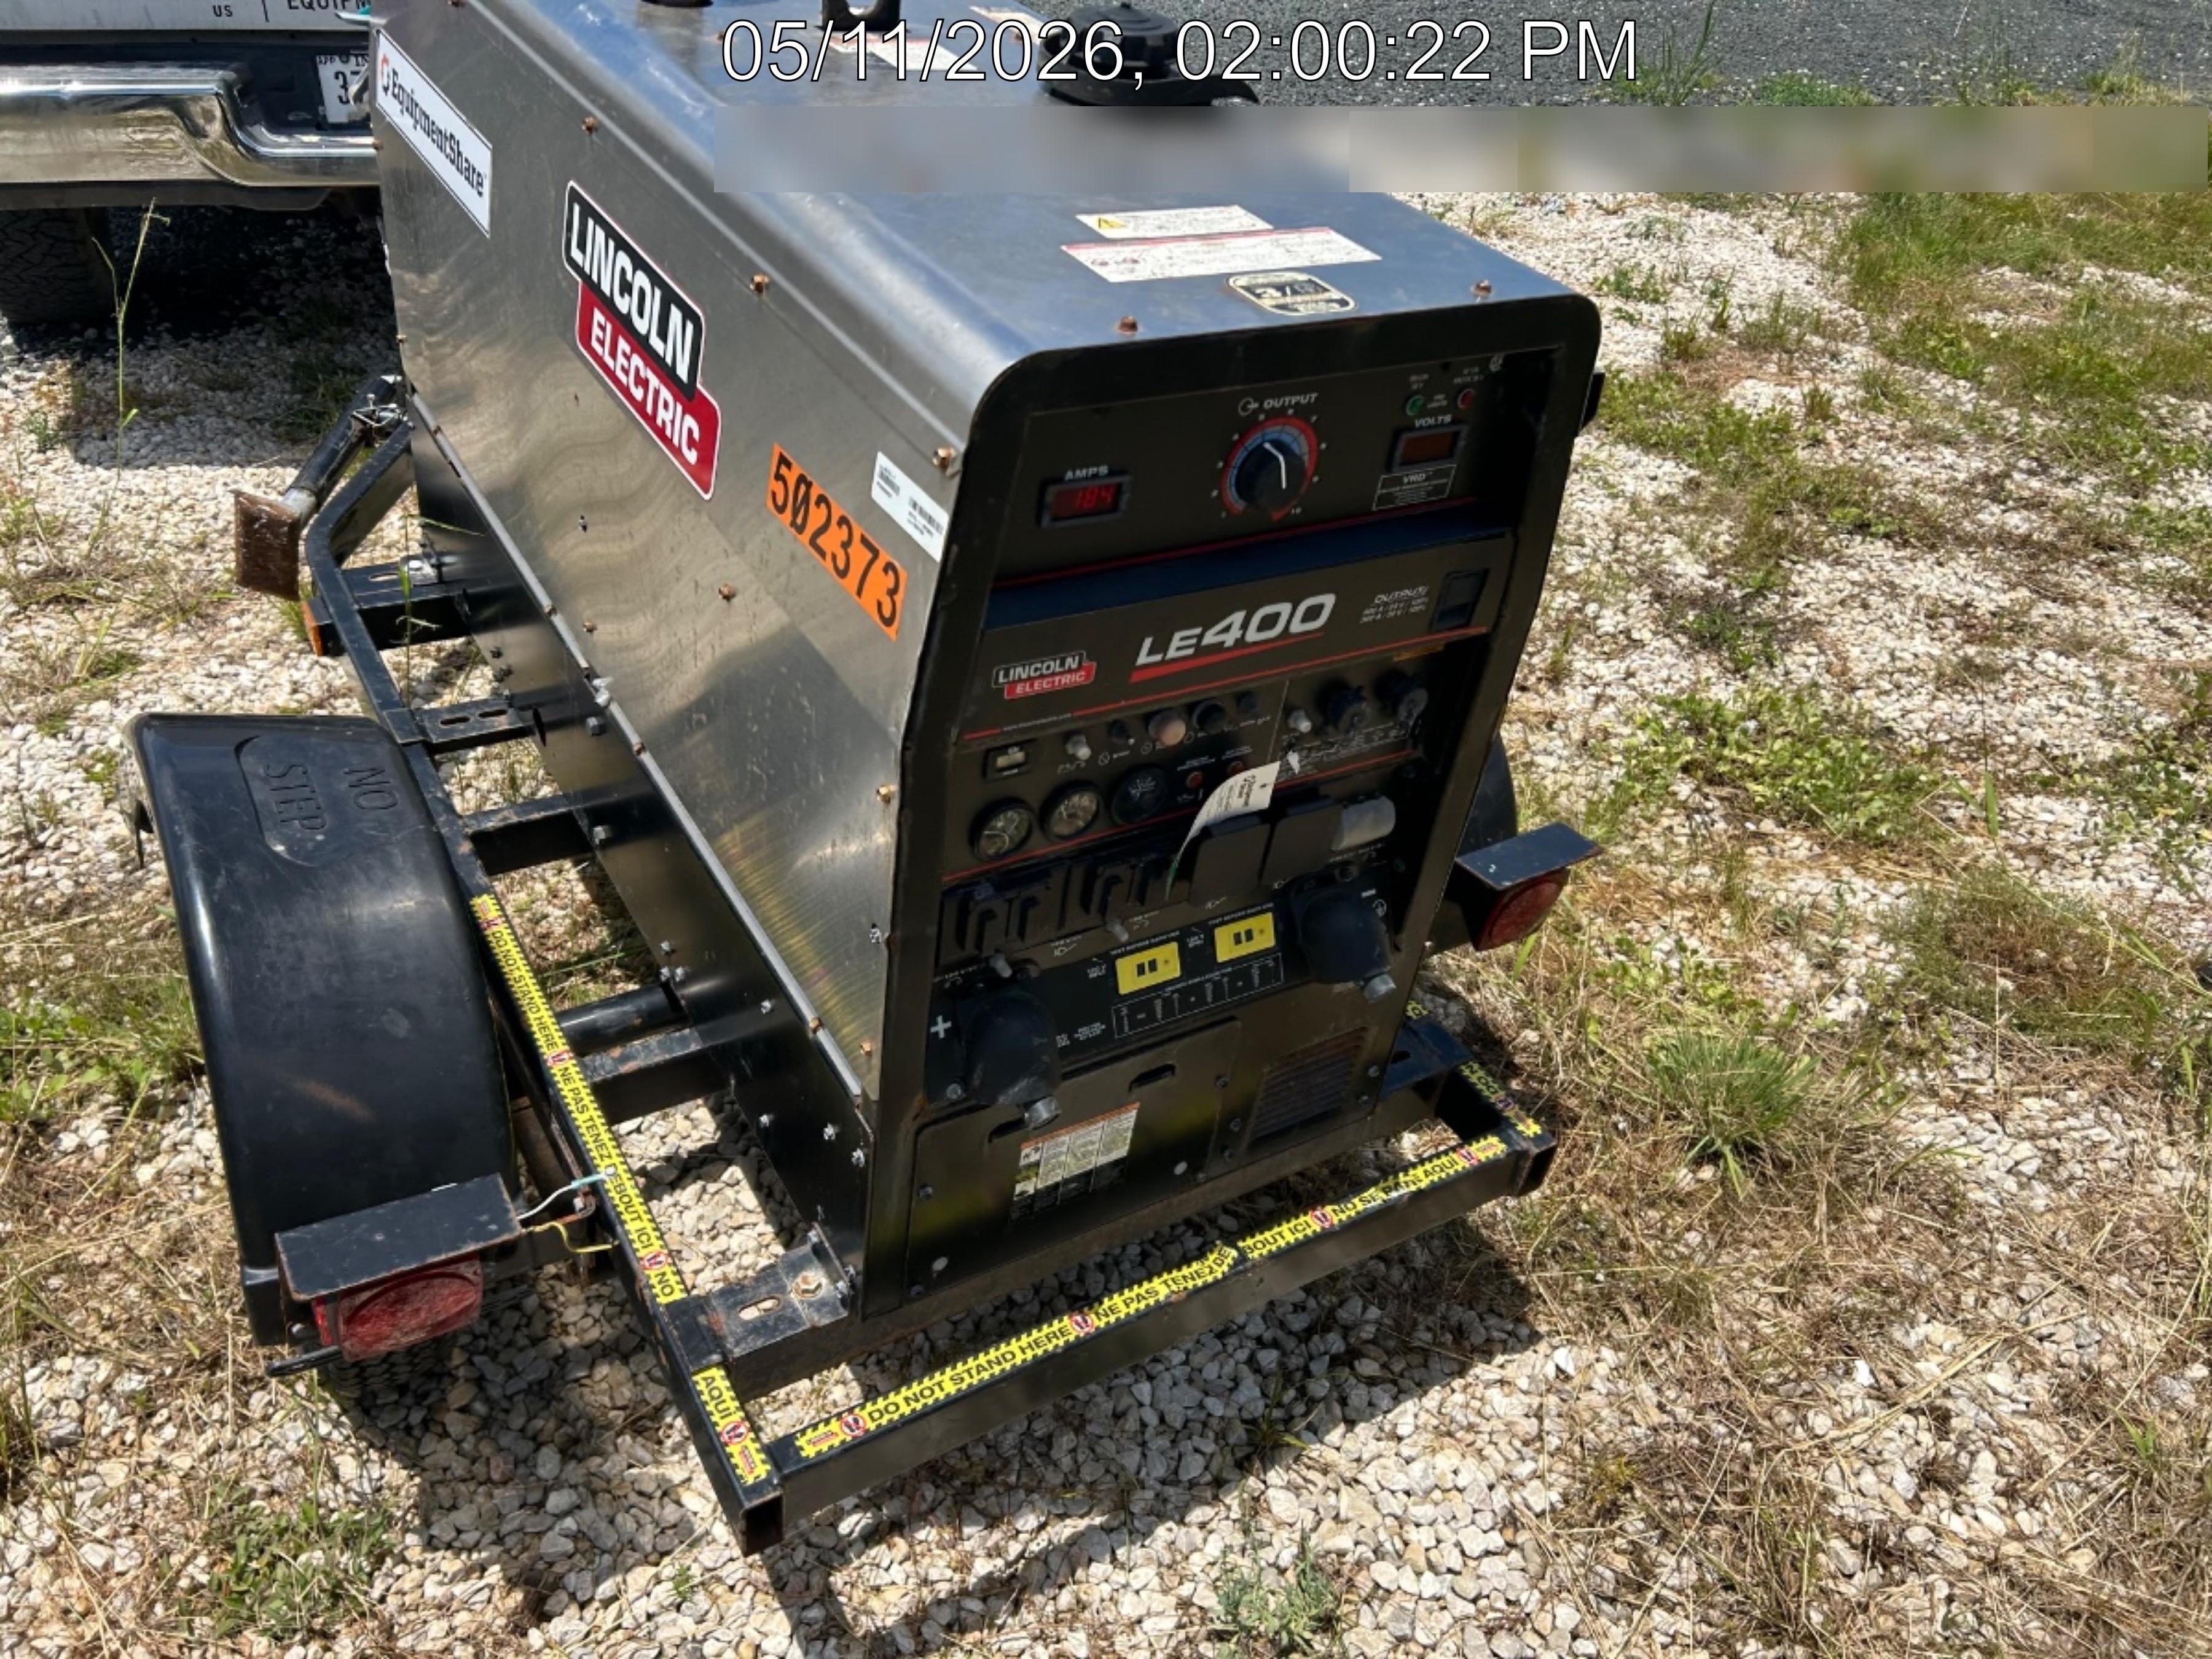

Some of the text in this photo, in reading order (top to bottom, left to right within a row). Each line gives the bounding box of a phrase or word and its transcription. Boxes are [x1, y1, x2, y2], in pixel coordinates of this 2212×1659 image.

[212, 4, 233, 17] US
[391, 68, 484, 198] EquipmentShare
[570, 203, 694, 384] LINCOLN
[590, 307, 700, 466] ELECTRIC
[1263, 392, 1319, 409] OUTPUT
[1414, 414, 1453, 428] VOLTS
[1065, 465, 1109, 481] AMPS
[1135, 593, 1337, 667] LE400
[998, 654, 1080, 683] LINCOLN
[1016, 670, 1086, 694] ELECTRIC
[264, 763, 327, 831] STEP
[343, 765, 399, 812] NO
[492, 930, 560, 1051] DO NOT STAND HERE
[558, 1066, 576, 1087] NE
[568, 1087, 589, 1115] PAS
[581, 1112, 613, 1161] TENEZ
[636, 1226, 655, 1249] ICI
[654, 1271, 674, 1297] NO
[1094, 1303, 1121, 1321] NE
[1122, 1285, 1159, 1309] PAS
[1290, 1220, 1312, 1236] ICI
[868, 1326, 1072, 1422] DO NOT STAND HERE
